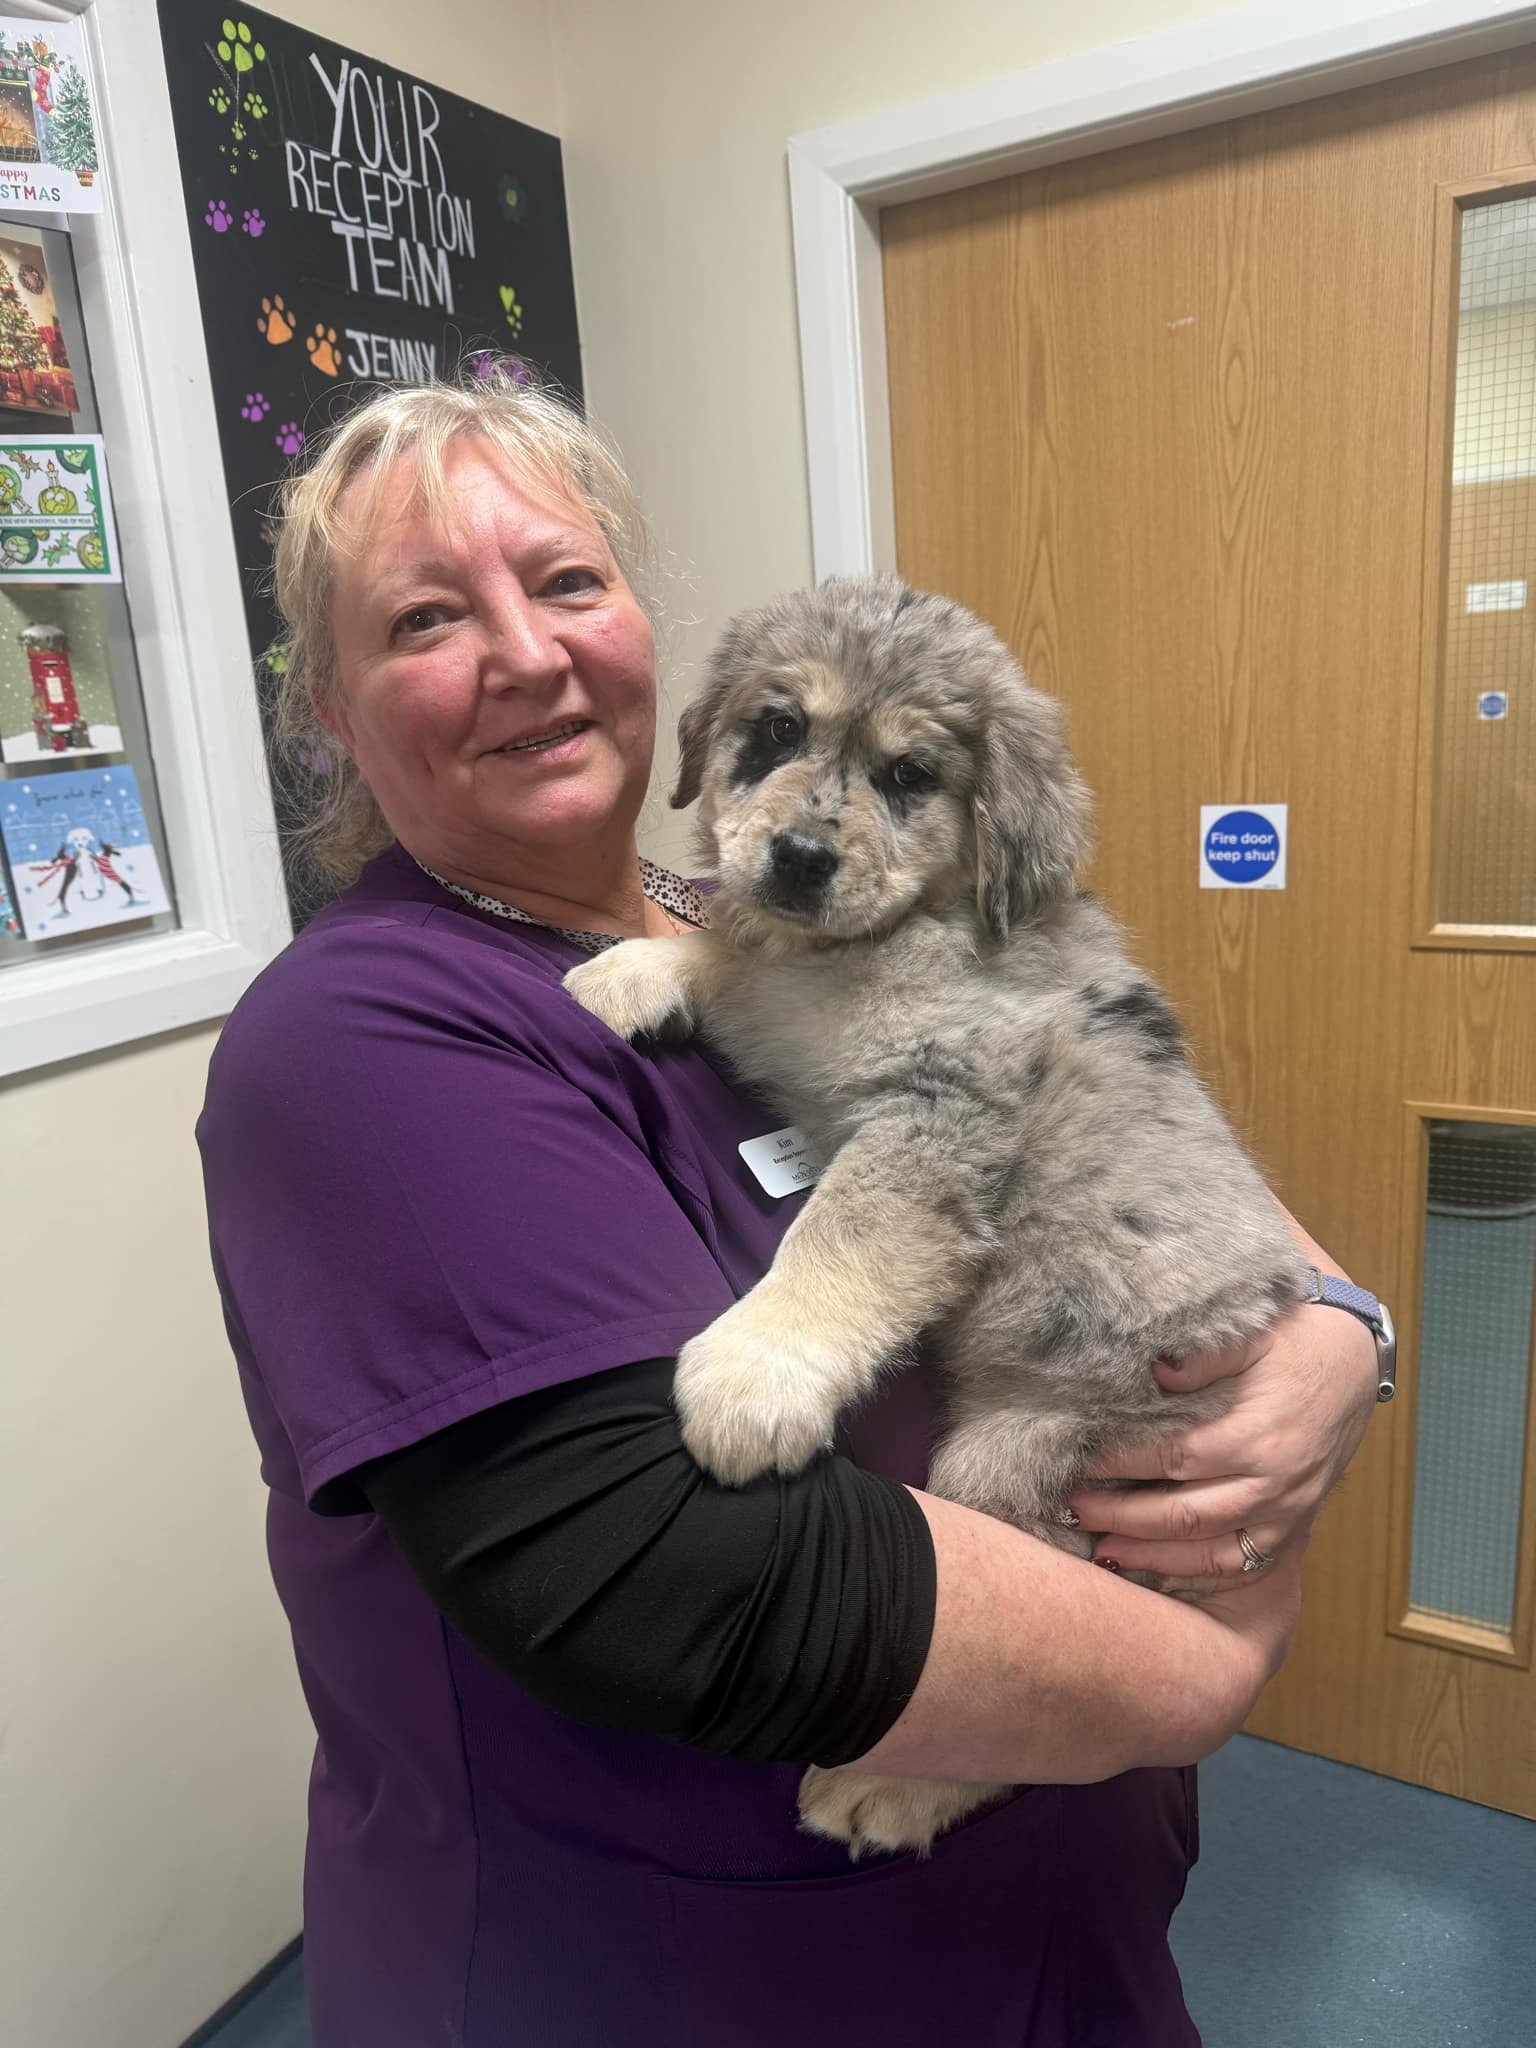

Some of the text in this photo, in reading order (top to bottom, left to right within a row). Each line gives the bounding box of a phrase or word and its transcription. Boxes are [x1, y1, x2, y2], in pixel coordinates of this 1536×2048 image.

[309, 52, 447, 193] YOUR
[0, 184, 61, 202] STMAS
[285, 140, 476, 259] RECEPTION
[331, 220, 455, 315] TEAM
[345, 328, 436, 386] JENNY
[1208, 849, 1275, 864] keep shut
[1211, 832, 1274, 845] Fire door
